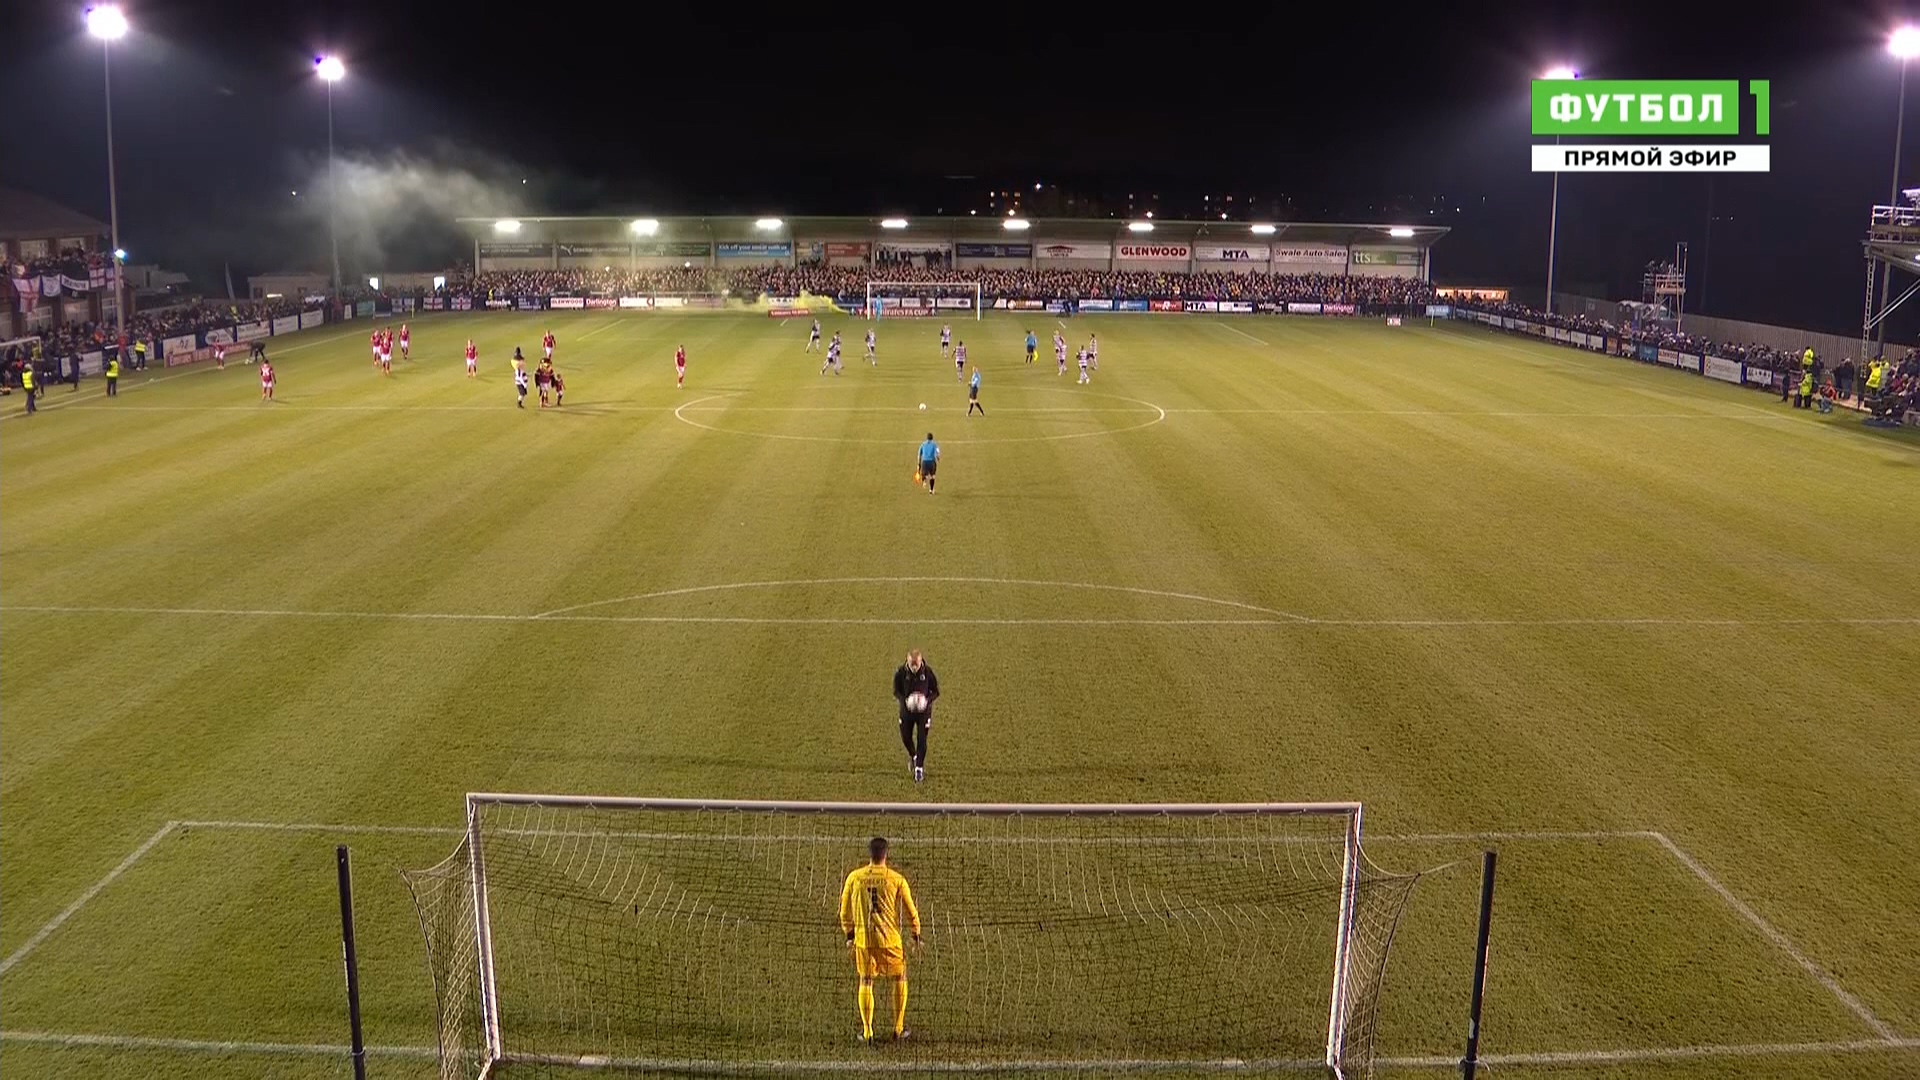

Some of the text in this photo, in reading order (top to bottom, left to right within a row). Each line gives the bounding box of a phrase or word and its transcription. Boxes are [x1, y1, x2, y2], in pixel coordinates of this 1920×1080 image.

[1121, 246, 1187, 257] GLENWOOD
[1222, 250, 1249, 259] MTA
[1275, 249, 1347, 258] Swale Auto Sales
[1354, 251, 1371, 263] tts
[586, 298, 617, 307] Darlington
[1185, 302, 1207, 310] MTA
[1323, 303, 1354, 313] Darlington
[867, 887, 881, 913] 1
